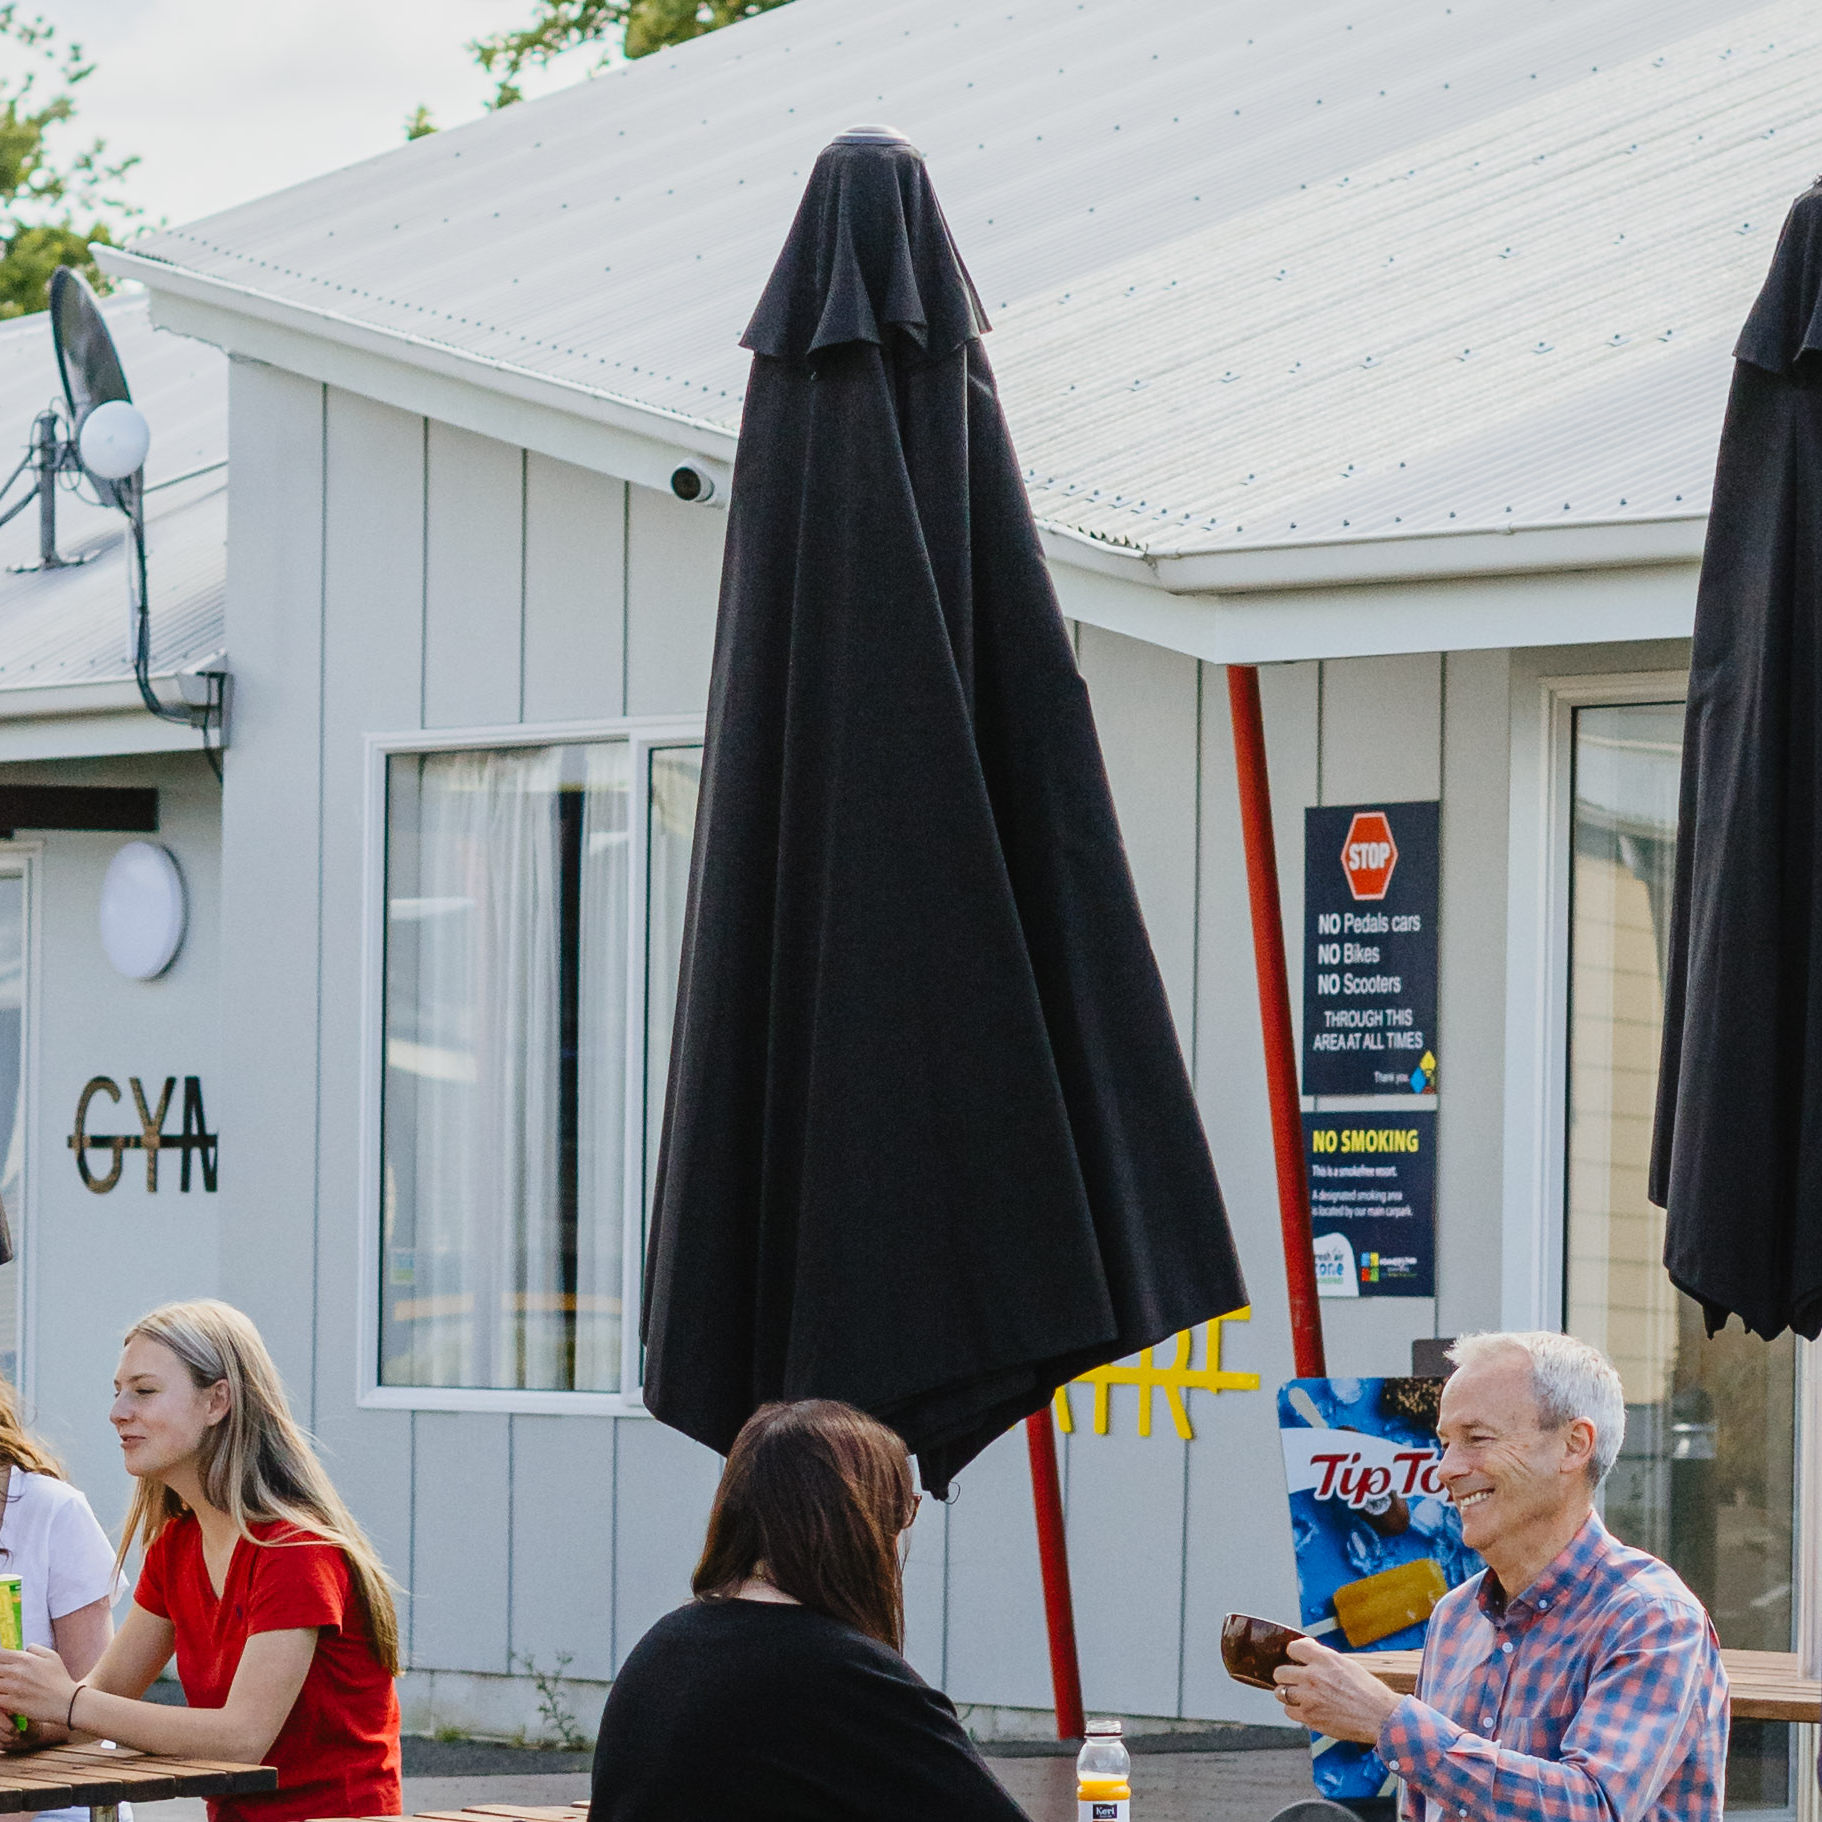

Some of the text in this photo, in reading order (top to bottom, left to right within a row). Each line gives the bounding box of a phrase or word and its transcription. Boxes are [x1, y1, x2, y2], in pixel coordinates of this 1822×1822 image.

[1348, 842, 1391, 870] STOP
[1318, 912, 1421, 935] NO Pedals cars
[1318, 942, 1380, 965] NO Bikes
[1318, 972, 1402, 995] NO Scooters
[1324, 1008, 1413, 1028] THROUGH THIS
[1312, 1031, 1424, 1051] AREA AT ALL TIMES
[1312, 1129, 1419, 1153] NO SMOKING
[1312, 1164, 1326, 1178] This
[1357, 1190, 1387, 1204] smoking
[1387, 1191, 1404, 1201] area
[1318, 1205, 1344, 1217] located
[1344, 1205, 1354, 1219] by
[1354, 1208, 1367, 1217] our
[1367, 1206, 1385, 1217] main
[1315, 1251, 1331, 1262] resh
[1316, 1263, 1344, 1276] one
[1310, 1452, 1454, 1505] Tip To
